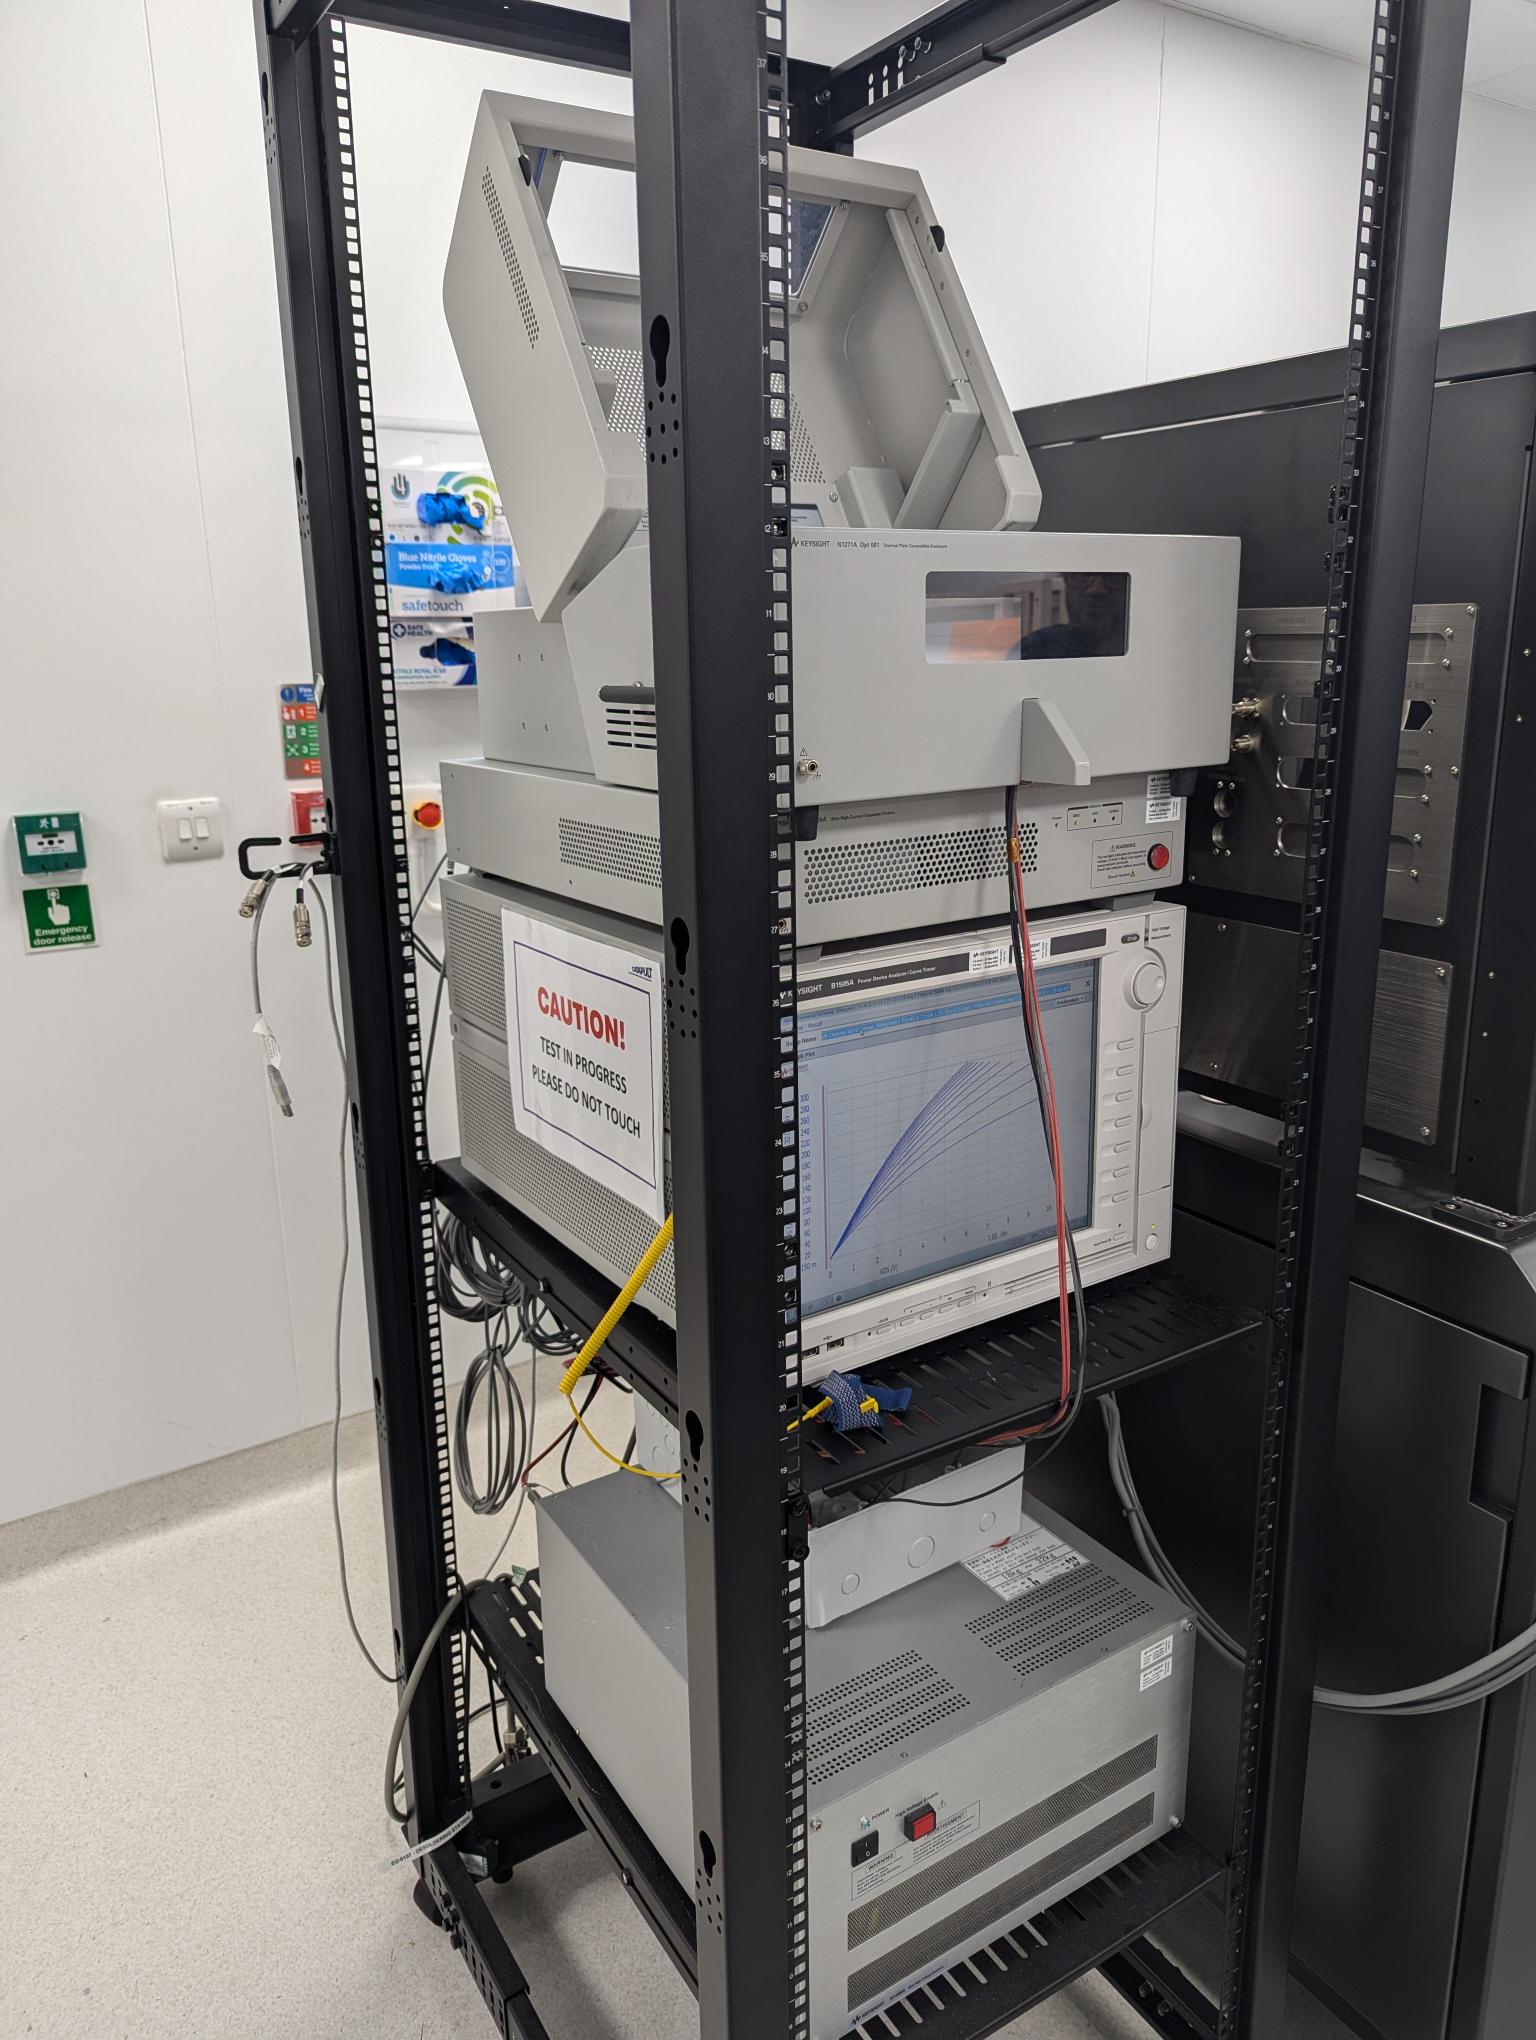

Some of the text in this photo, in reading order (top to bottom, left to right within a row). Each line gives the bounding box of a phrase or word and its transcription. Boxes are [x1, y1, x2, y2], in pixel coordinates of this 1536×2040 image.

[1353, 469, 1360, 477] 33
[1347, 536, 1353, 544] 32
[402, 600, 464, 612] safetouch
[1335, 665, 1342, 673] 30
[299, 707, 305, 717] 1
[300, 727, 307, 736] 2
[302, 745, 309, 754] 3
[303, 763, 310, 771] 4
[35, 925, 88, 937] Emergency
[34, 934, 92, 946] door release
[831, 980, 854, 990] B1505A
[537, 986, 626, 1051] CAUTION!
[540, 1036, 627, 1094] TEST IN PROGRESS
[532, 1063, 641, 1139] PLEASE DO NOT TOUCH
[774, 1139, 782, 1147] 24
[801, 1150, 811, 1158] 200
[802, 1184, 811, 1192] 140
[803, 1195, 812, 1203] 120
[776, 1207, 783, 1216] 23
[803, 1207, 812, 1215] 100
[804, 1240, 811, 1248] 40
[805, 1251, 811, 1259] 20
[875, 1256, 880, 1264] 2
[776, 1275, 784, 1283] 22
[778, 1340, 785, 1348] 21
[779, 1404, 787, 1412] 20
[871, 1807, 890, 1820] POWER
[867, 1853, 894, 1871] WARNING
